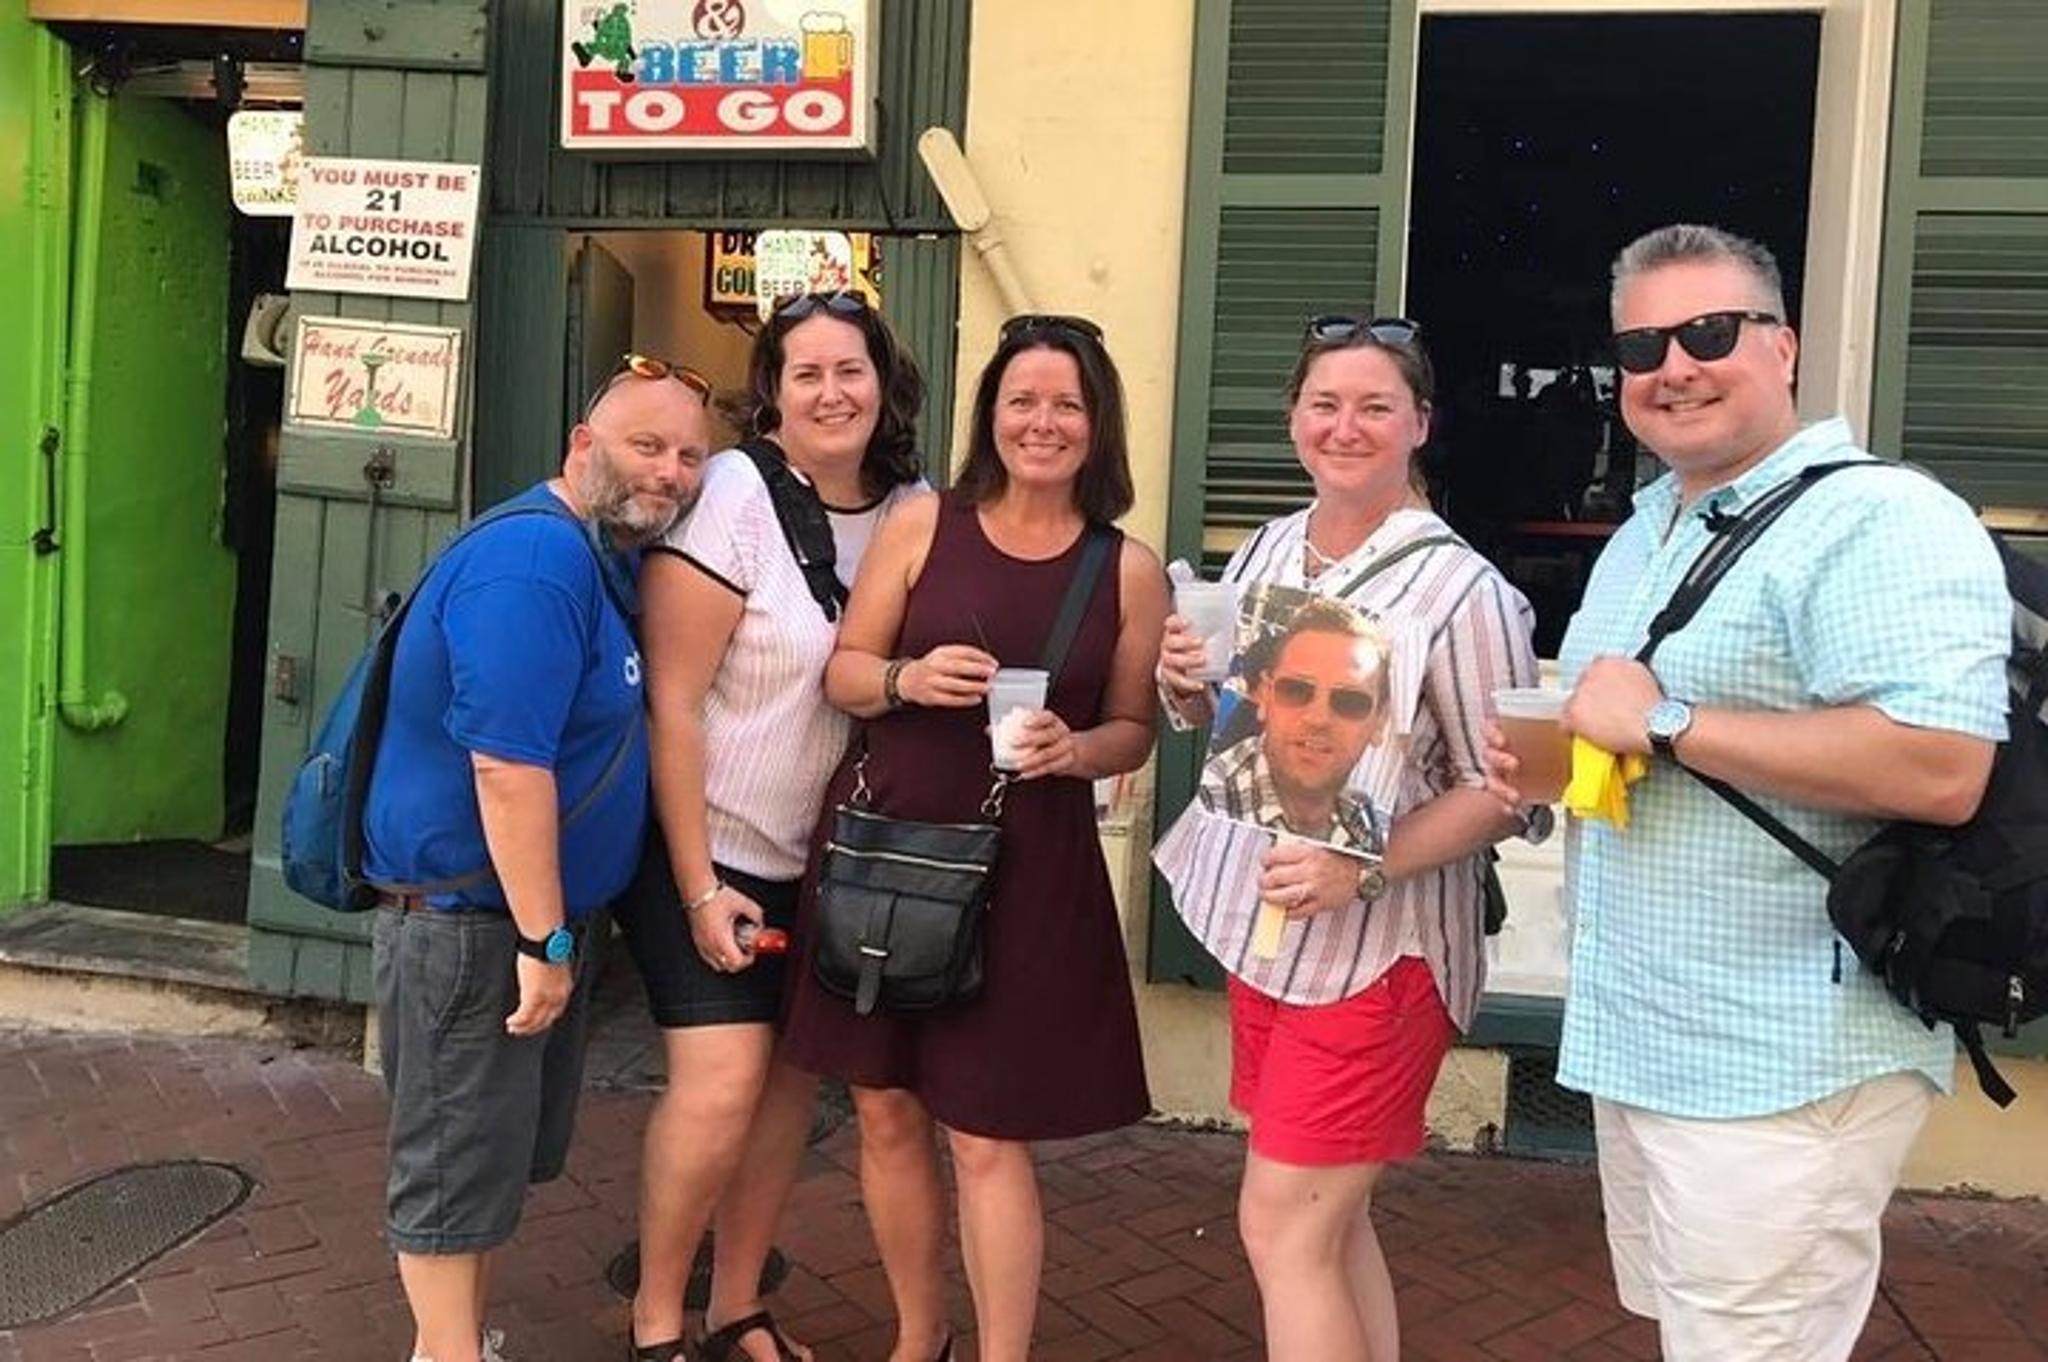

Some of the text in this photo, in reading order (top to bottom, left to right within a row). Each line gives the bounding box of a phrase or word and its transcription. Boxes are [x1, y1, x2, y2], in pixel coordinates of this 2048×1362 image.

[698, 0, 741, 38] &
[640, 40, 801, 84] BEER
[577, 90, 846, 132] TO GO
[311, 168, 467, 191] YOU MUST BE
[365, 190, 402, 212] 21
[303, 213, 464, 238] TO PURCHASE
[309, 235, 450, 262] ALCOHOL
[761, 279, 805, 298] BEER
